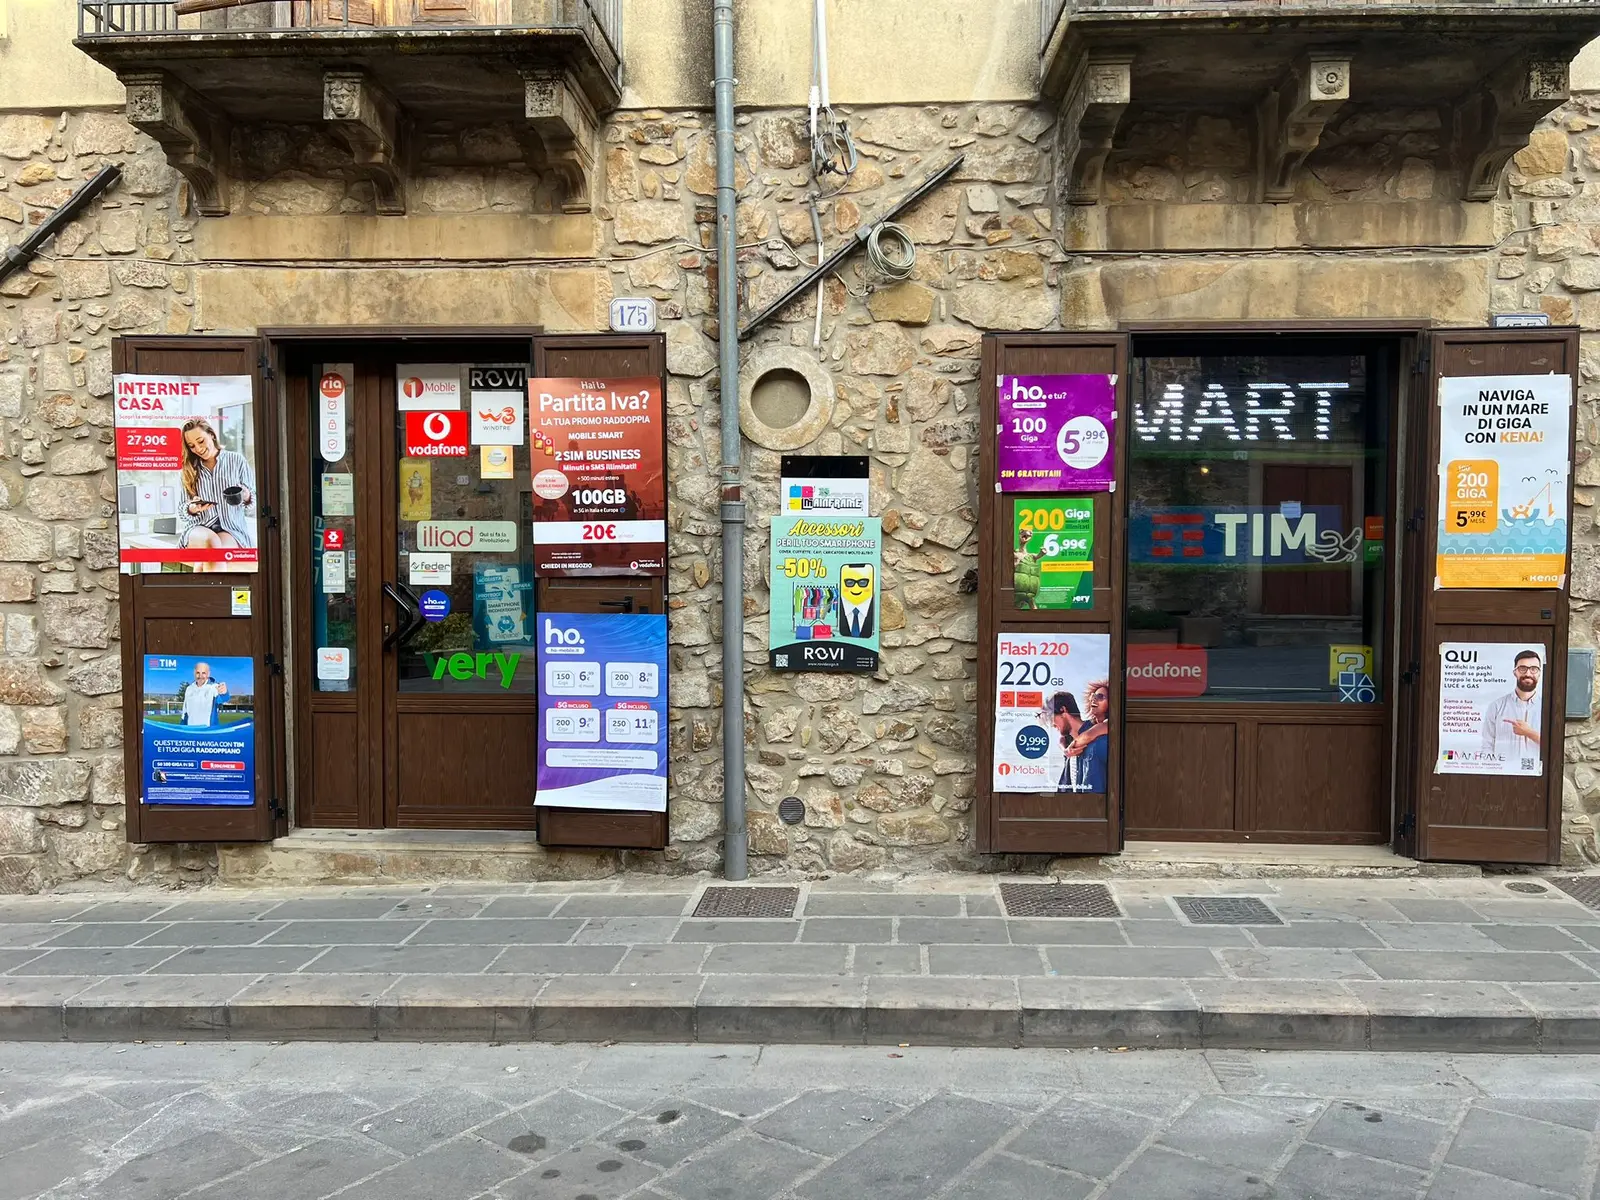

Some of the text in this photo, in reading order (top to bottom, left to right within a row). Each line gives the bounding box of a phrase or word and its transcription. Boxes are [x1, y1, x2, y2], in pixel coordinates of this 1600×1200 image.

[620, 305, 647, 326] 175
[322, 377, 342, 389] ria
[471, 370, 523, 387] ROVI
[581, 381, 606, 389] Hai la
[118, 382, 200, 395] INTERNET
[425, 382, 456, 392] Mobile
[1012, 378, 1047, 400] ho.
[1053, 392, 1067, 400] tu?
[539, 390, 650, 412] Partita Iva?
[1478, 389, 1535, 402] NAVIGA
[118, 398, 164, 410] CASA
[1462, 402, 1549, 416] IN UN MARE
[541, 418, 553, 426] LA
[571, 417, 601, 425] PROMO
[603, 415, 650, 424] RADDOPPIA
[1012, 417, 1047, 433] 100
[1477, 417, 1532, 430] DI GIGA
[127, 435, 167, 446] 27,90€
[568, 431, 624, 440] MOBILE SMART
[1020, 435, 1038, 443] Giga
[1465, 431, 1544, 444] CON KENA!
[408, 443, 467, 455] vodafone
[555, 449, 641, 461] 2 SIM BUSINESS
[1001, 470, 1015, 478] SIM
[1457, 472, 1488, 487] 200
[572, 489, 626, 505] 100GB
[1457, 488, 1487, 498] GIGA
[1019, 508, 1090, 531] 200 Giga
[582, 524, 616, 540] 20€
[788, 519, 864, 537] Accessori
[423, 526, 474, 547] iliad
[1214, 513, 1316, 557] TIM
[776, 539, 876, 548] PER IL TUO SMARTPHONE
[1043, 534, 1087, 557] 6,99€
[420, 561, 450, 570] feder
[775, 558, 827, 578] -50%
[545, 618, 585, 645] ho.
[804, 647, 844, 660] ROVI
[1000, 641, 1069, 656] Flash 220
[159, 659, 177, 667] TIM
[1445, 650, 1478, 663] QUI
[423, 652, 521, 689] very
[1000, 661, 1064, 686] 220 GB
[1018, 734, 1048, 747] 9,99€
[1013, 765, 1045, 775] Mobile
